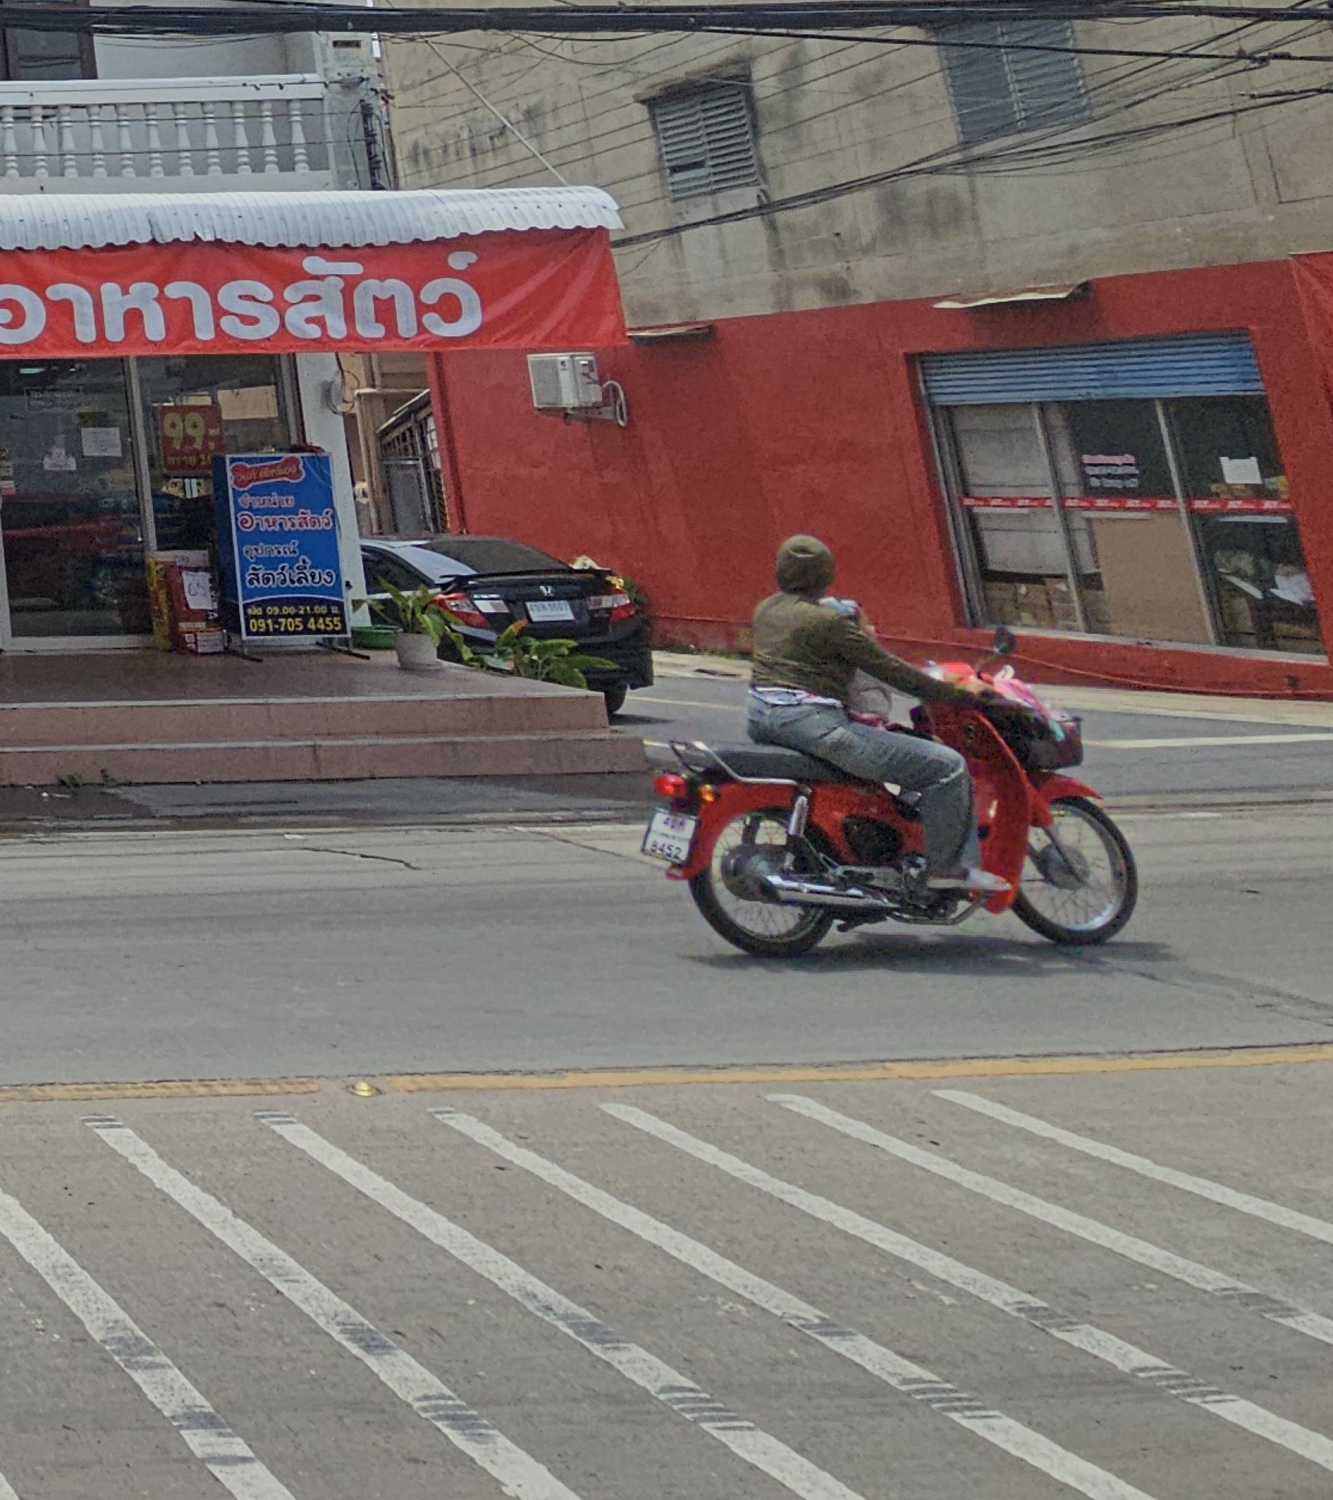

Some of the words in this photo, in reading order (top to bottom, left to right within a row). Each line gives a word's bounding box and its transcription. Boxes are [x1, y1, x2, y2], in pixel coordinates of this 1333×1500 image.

[163, 412, 205, 450] 99
[237, 508, 333, 531] อาหารสัตว์
[243, 539, 299, 562] อุปกรณ์
[246, 556, 335, 589] สัตว์เลี้ยง
[249, 618, 304, 632] 091-705
[307, 617, 342, 631] 4455
